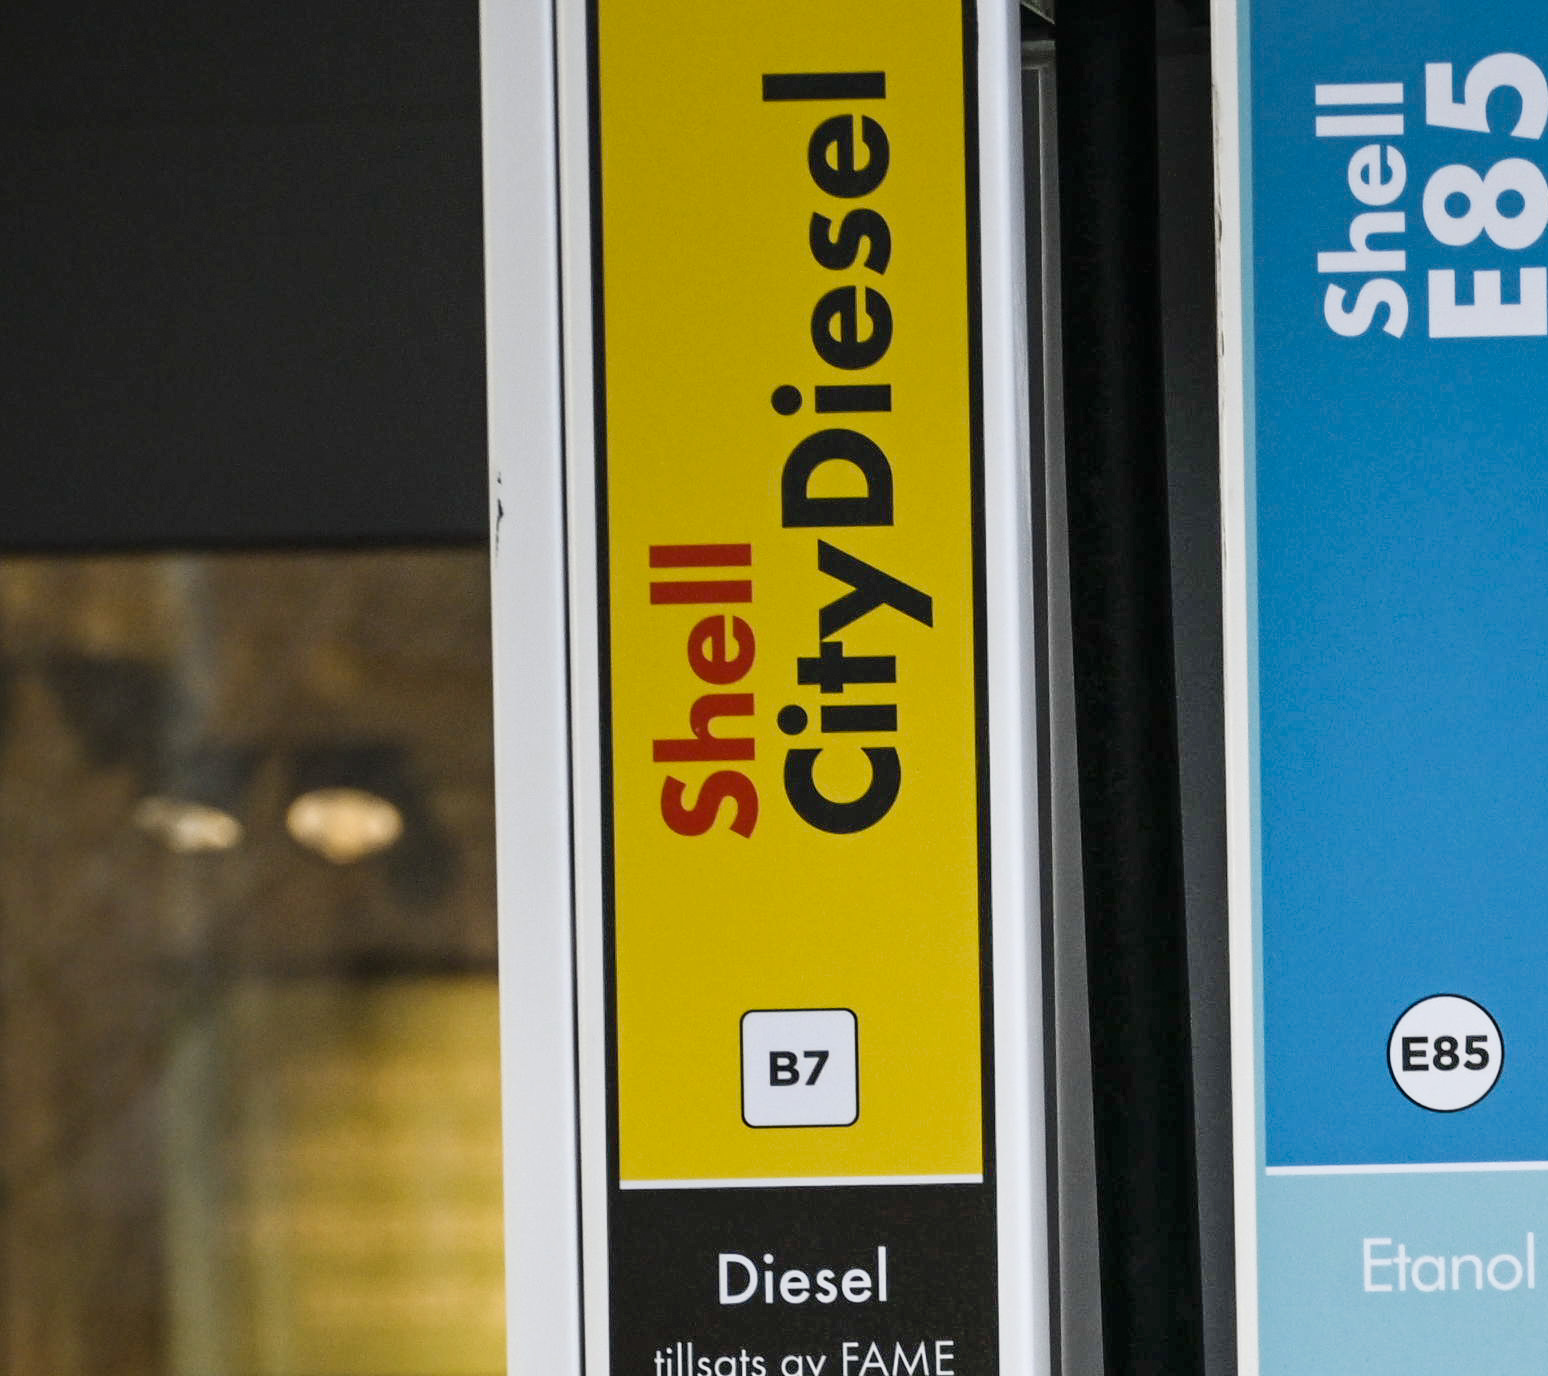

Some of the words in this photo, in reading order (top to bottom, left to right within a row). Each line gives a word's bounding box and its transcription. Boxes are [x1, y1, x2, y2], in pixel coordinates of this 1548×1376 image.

[1315, 83, 1408, 338] Shell
[762, 71, 933, 834] CityDiesel
[649, 543, 757, 838] Shell
[770, 1050, 829, 1086] B7
[1400, 1035, 1490, 1073] E85
[719, 1246, 887, 1304] Diesel
[1363, 1232, 1535, 1292] Etanol
